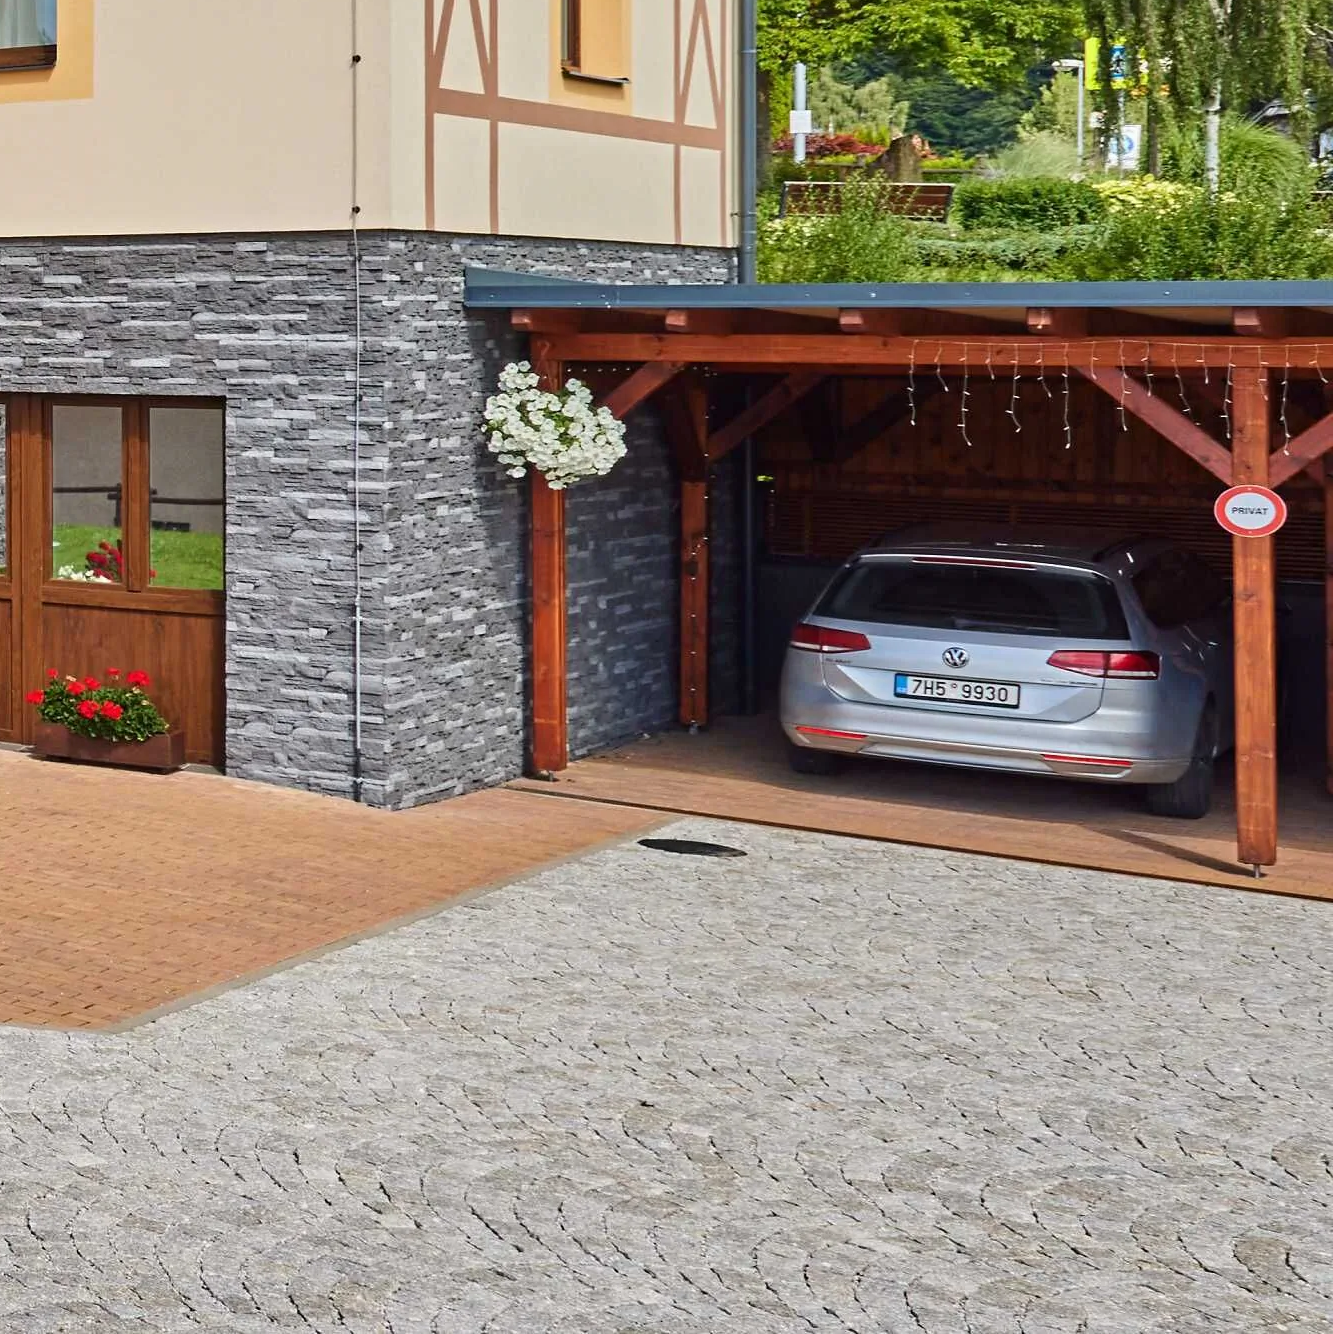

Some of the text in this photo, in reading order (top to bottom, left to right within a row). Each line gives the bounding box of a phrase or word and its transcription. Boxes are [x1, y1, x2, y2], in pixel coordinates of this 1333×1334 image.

[1231, 506, 1269, 515] PRIVAT
[911, 679, 1008, 702] 7H5 9930
